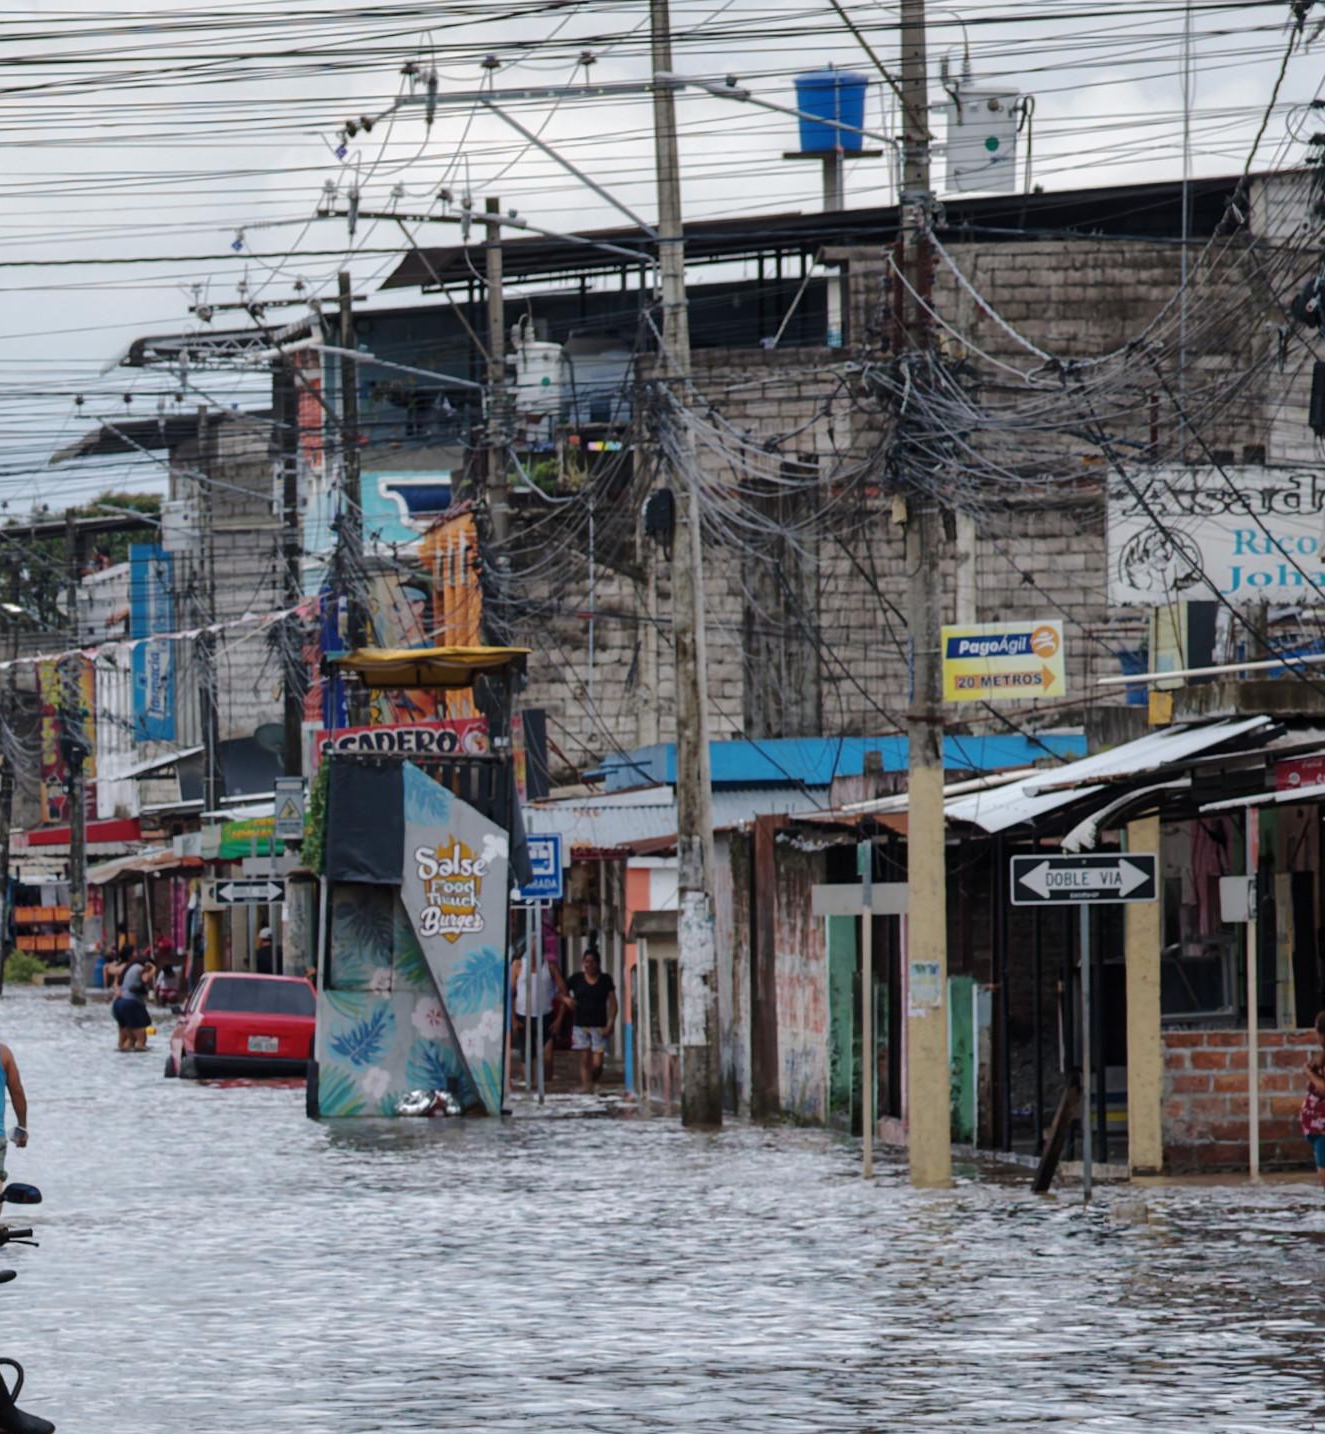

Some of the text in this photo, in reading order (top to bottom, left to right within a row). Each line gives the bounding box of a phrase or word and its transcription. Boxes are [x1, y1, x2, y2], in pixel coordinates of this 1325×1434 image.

[1122, 474, 1325, 516] Asad
[1233, 528, 1318, 556] Rico
[959, 634, 1027, 655] PagoÁgil
[959, 673, 1042, 689] 20 METROS
[1046, 871, 1124, 887] DOBLE VIA
